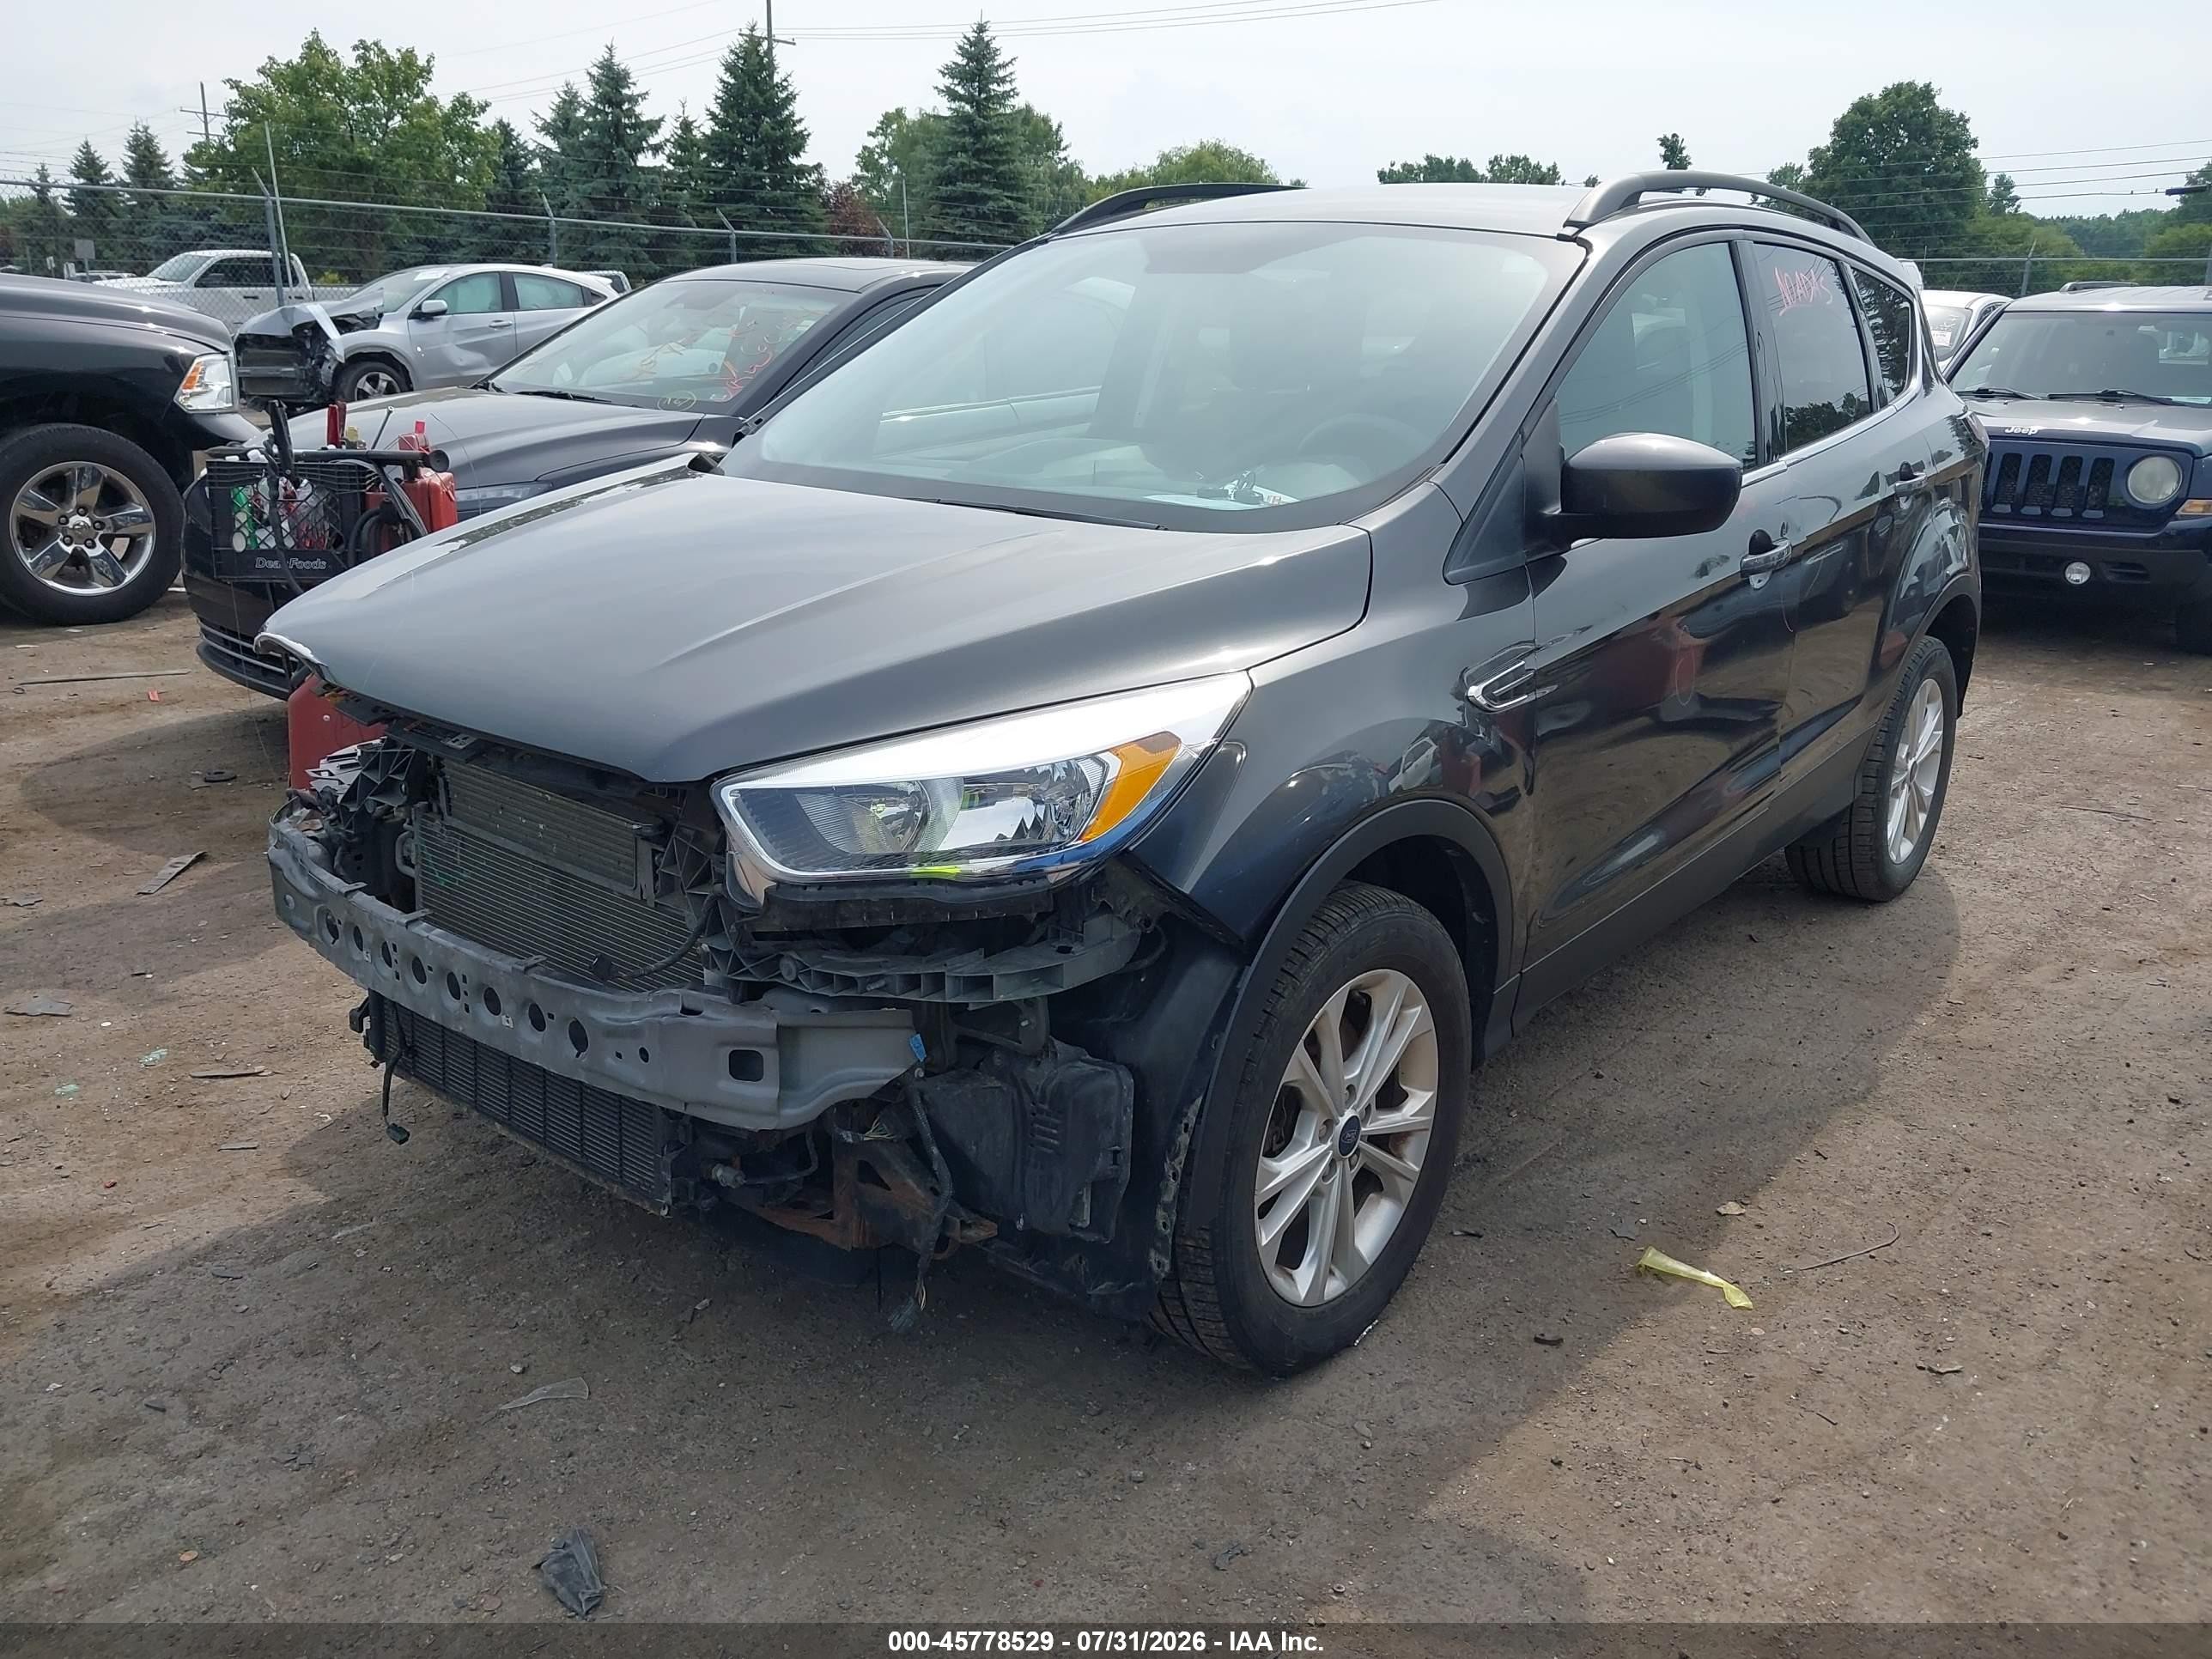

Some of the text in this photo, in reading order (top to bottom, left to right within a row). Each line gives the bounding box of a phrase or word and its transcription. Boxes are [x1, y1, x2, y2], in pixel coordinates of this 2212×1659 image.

[2004, 425, 2039, 435] Jeep
[255, 556, 327, 569] Dea Foods
